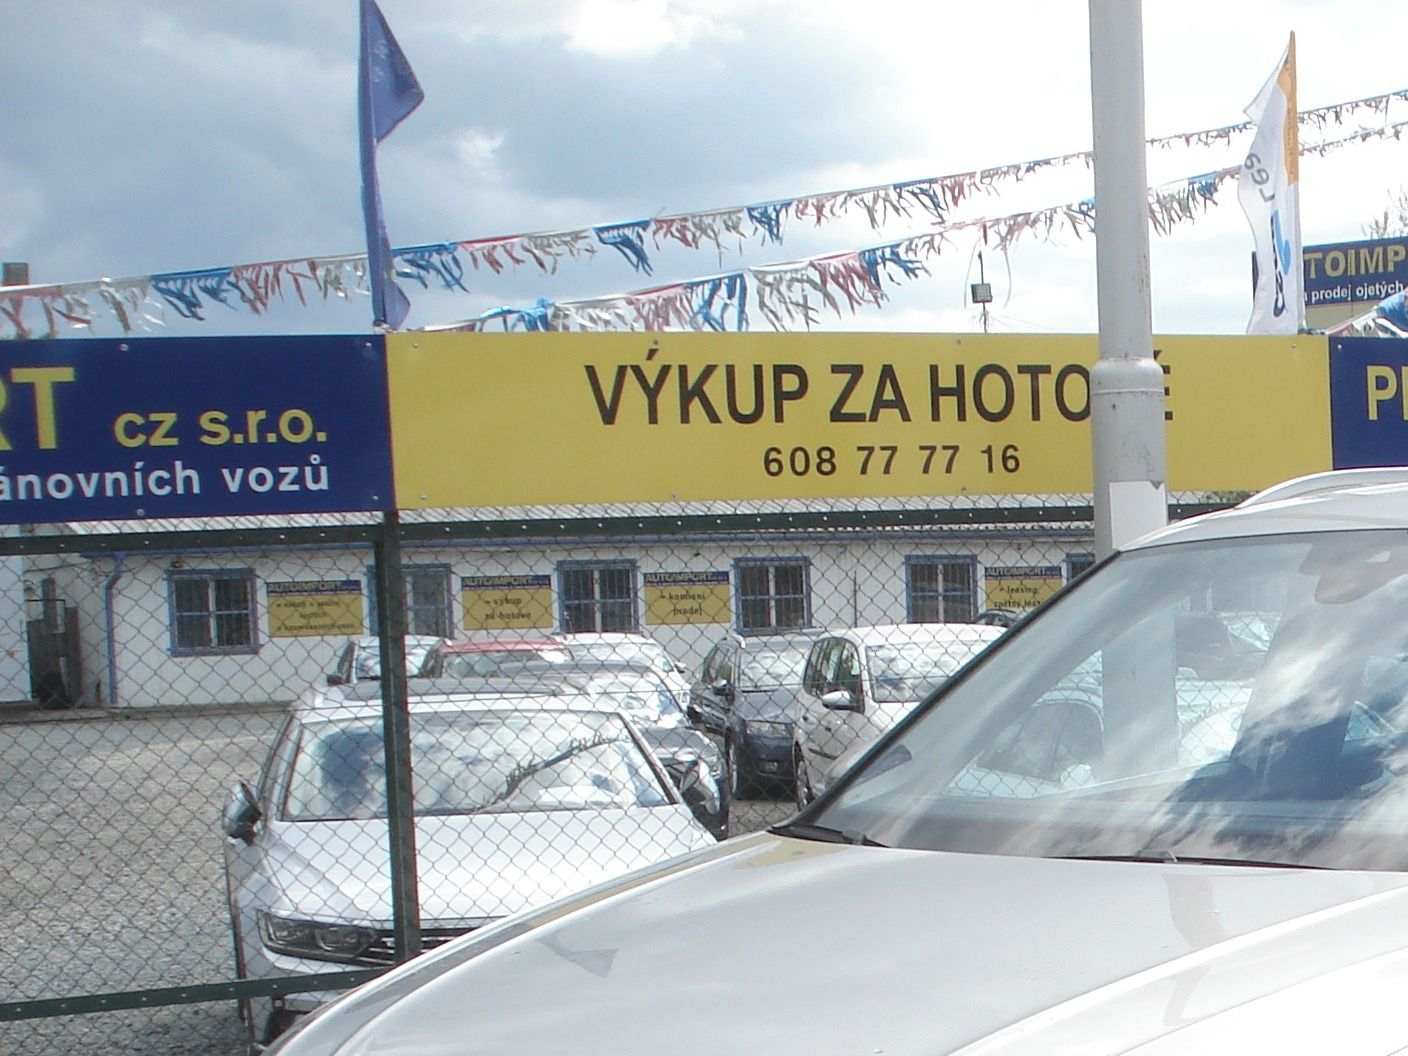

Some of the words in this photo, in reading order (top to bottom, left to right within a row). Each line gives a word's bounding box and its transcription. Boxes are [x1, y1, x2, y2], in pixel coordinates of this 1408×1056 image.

[1312, 284, 1352, 304] prodej
[1356, 280, 1404, 300] ojetých
[584, 348, 810, 426] VÝKUP
[829, 363, 912, 424] ZA
[930, 350, 1174, 423] HOTO
[0, 367, 76, 450] T
[113, 412, 179, 448] cz
[199, 408, 328, 445] s.r.o.
[221, 454, 330, 494] vozů
[763, 445, 838, 477] 608
[856, 445, 899, 476] 77
[918, 444, 961, 475] 77
[979, 443, 1021, 474] 16
